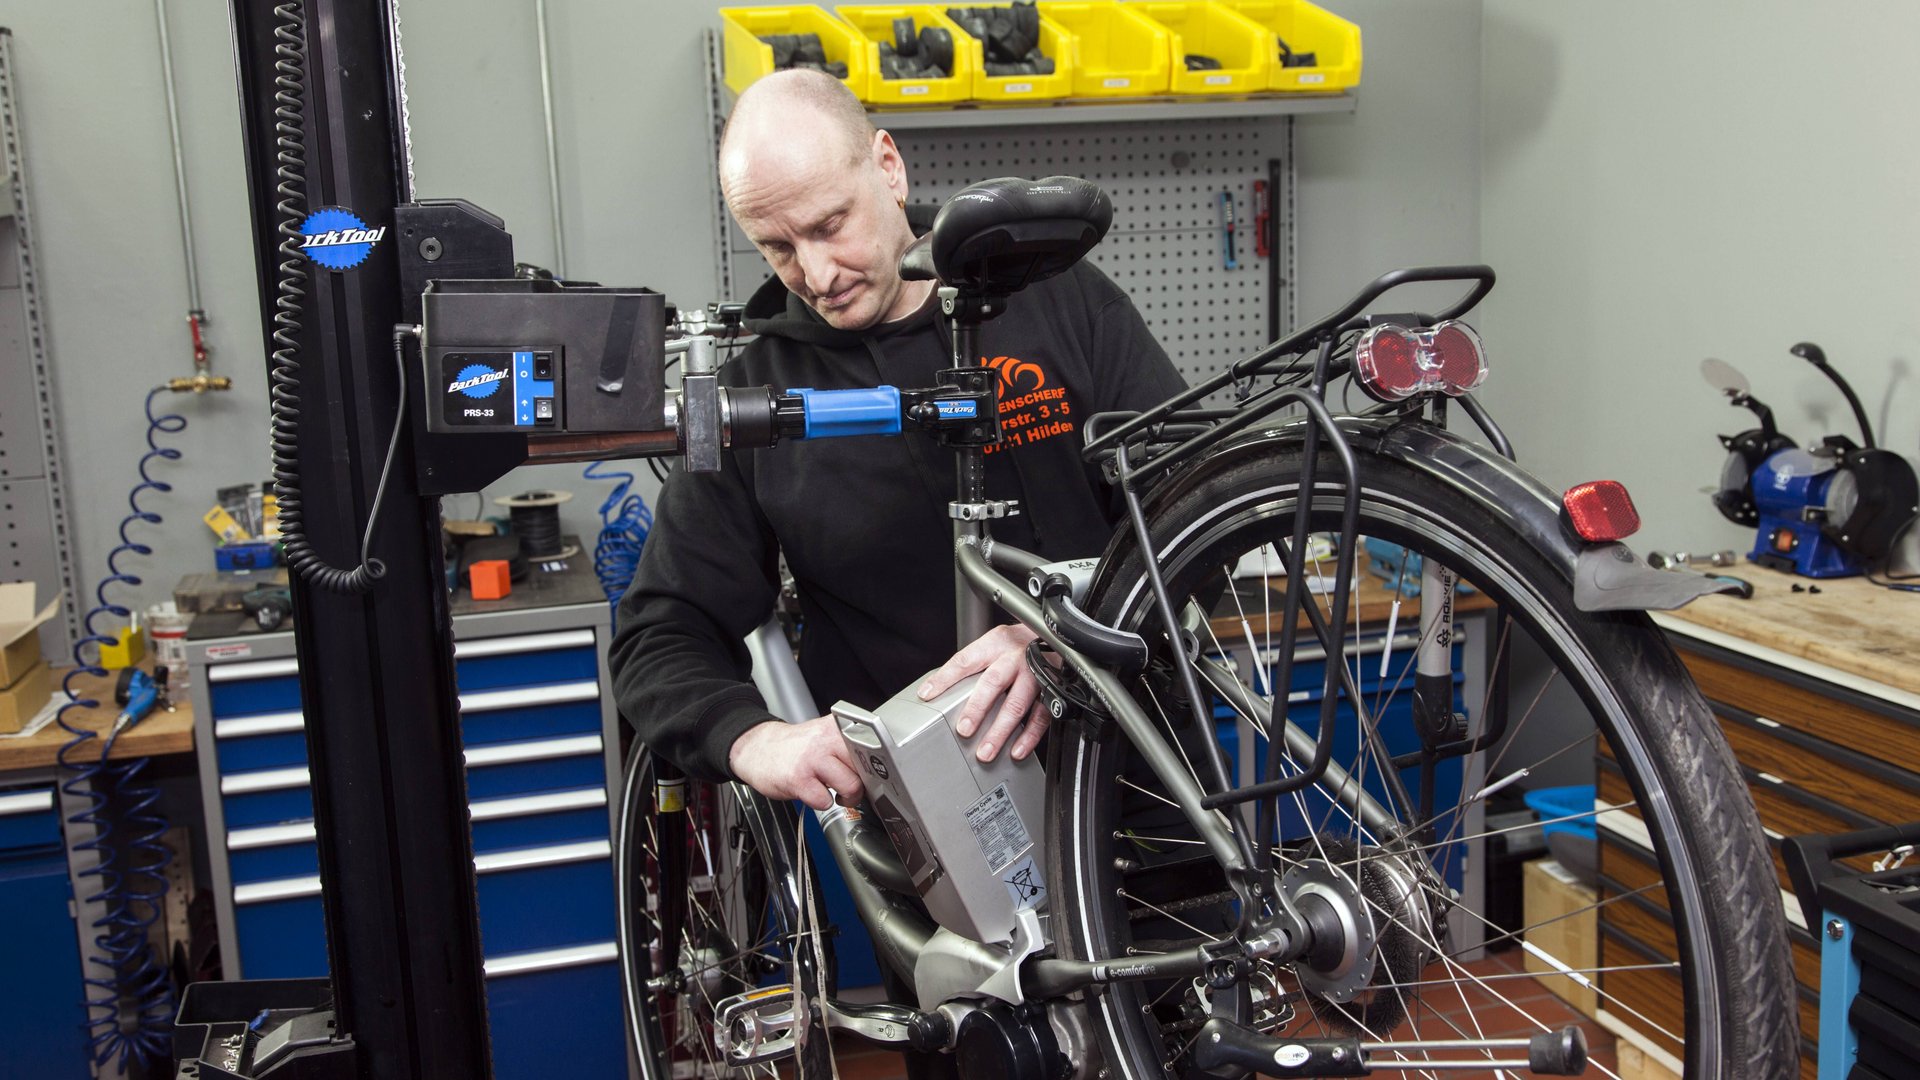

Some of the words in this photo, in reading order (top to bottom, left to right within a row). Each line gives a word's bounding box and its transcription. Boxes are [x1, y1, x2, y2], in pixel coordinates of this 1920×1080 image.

[292, 226, 386, 249] arkTool
[938, 406, 975, 414] ParkToo
[998, 387, 1066, 414] ENSCHERF
[464, 408, 495, 417] PRS-33
[1001, 412, 1036, 431] rstr.
[1038, 405, 1051, 419] 3
[1060, 401, 1071, 415] 5
[1068, 561, 1095, 569] AXA
[966, 806, 980, 817] Derby
[979, 796, 993, 807] Cycle
